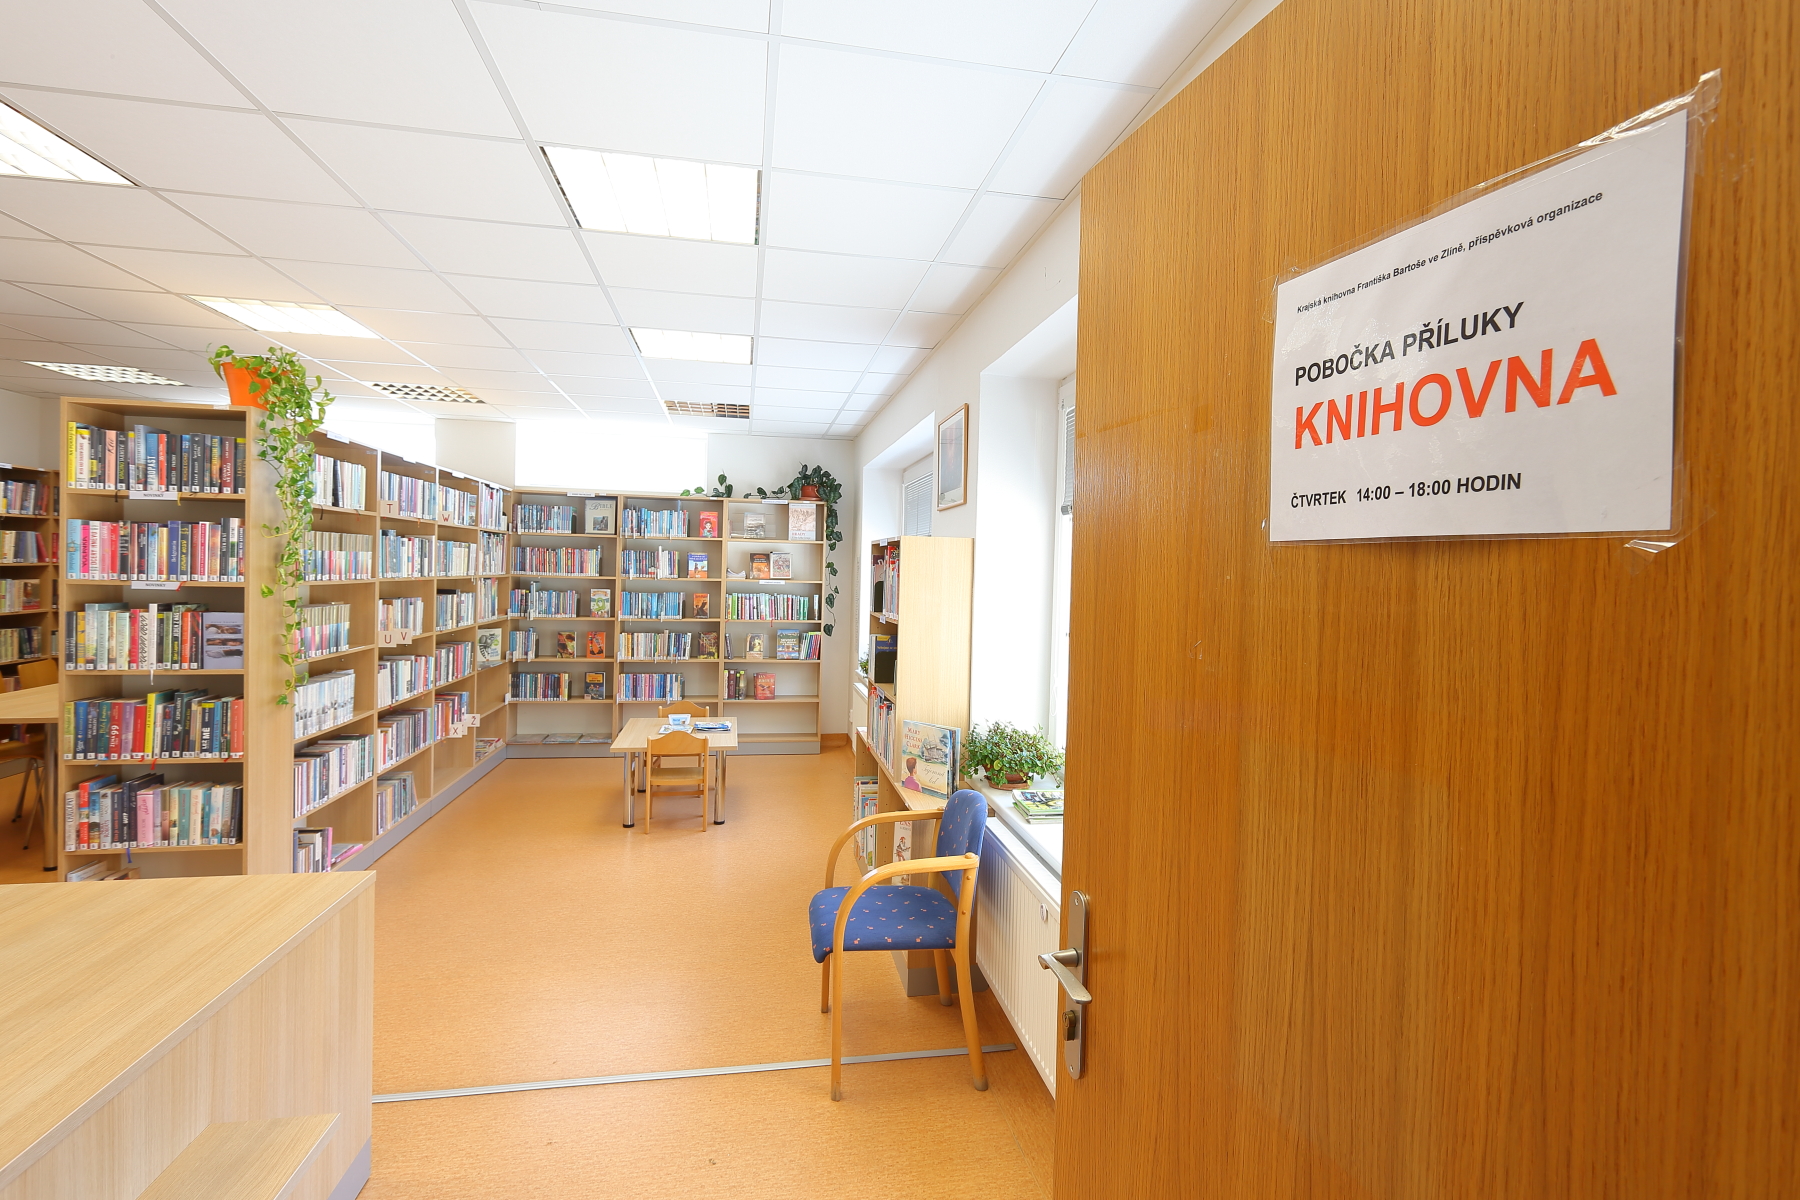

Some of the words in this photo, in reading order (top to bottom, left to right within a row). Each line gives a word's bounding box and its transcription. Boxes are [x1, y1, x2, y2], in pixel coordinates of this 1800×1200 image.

[1297, 297, 1321, 313] Krajská
[1323, 287, 1355, 304] knihovna
[1357, 272, 1391, 292] Františka
[1393, 258, 1426, 277] Bartoše
[1428, 254, 1439, 264] ve
[1441, 242, 1466, 260] Zlíně,
[1468, 216, 1534, 251] příspěvková
[1536, 192, 1603, 222] organizace
[1295, 341, 1396, 387] POBOČKA
[1402, 301, 1525, 357] PŘÍLUKY
[1294, 337, 1618, 450] KNIHOVNA
[147, 456, 156, 481] PROPAST
[1290, 489, 1347, 509] ČTVRTEK
[1356, 485, 1391, 502] 14:00
[1408, 480, 1451, 498] 18:00
[1456, 473, 1522, 494] HODIN
[387, 503, 393, 514] T
[442, 514, 450, 522] W
[384, 634, 392, 644] U
[401, 632, 407, 641] V
[111, 725, 119, 735] 99
[907, 726, 920, 735] MARY
[904, 733, 922, 743] HIGGINS
[906, 741, 920, 749] CLARK
